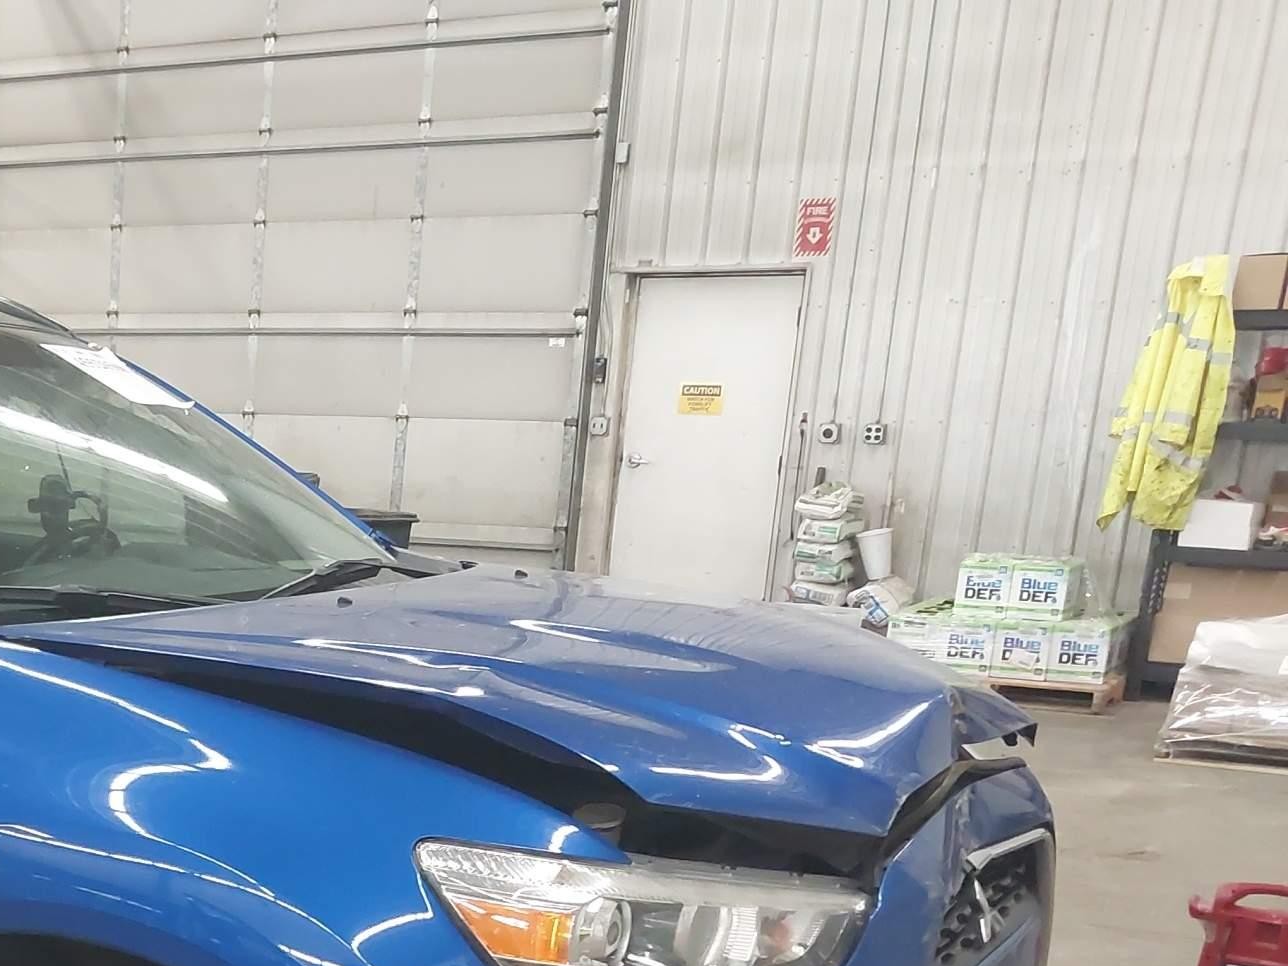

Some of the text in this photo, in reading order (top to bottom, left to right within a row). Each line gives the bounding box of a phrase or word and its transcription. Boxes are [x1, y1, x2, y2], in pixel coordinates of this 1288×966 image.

[806, 206, 829, 216] FIRE
[684, 386, 720, 394] CAUTION
[1020, 577, 1058, 591] Blue
[964, 587, 1001, 601] DEF
[1018, 589, 1056, 603] DEF
[948, 633, 985, 647] Blue
[1003, 637, 1041, 651] Blue
[1060, 640, 1100, 654] Blue
[947, 645, 984, 659] DEF
[1058, 652, 1098, 666] DEF
